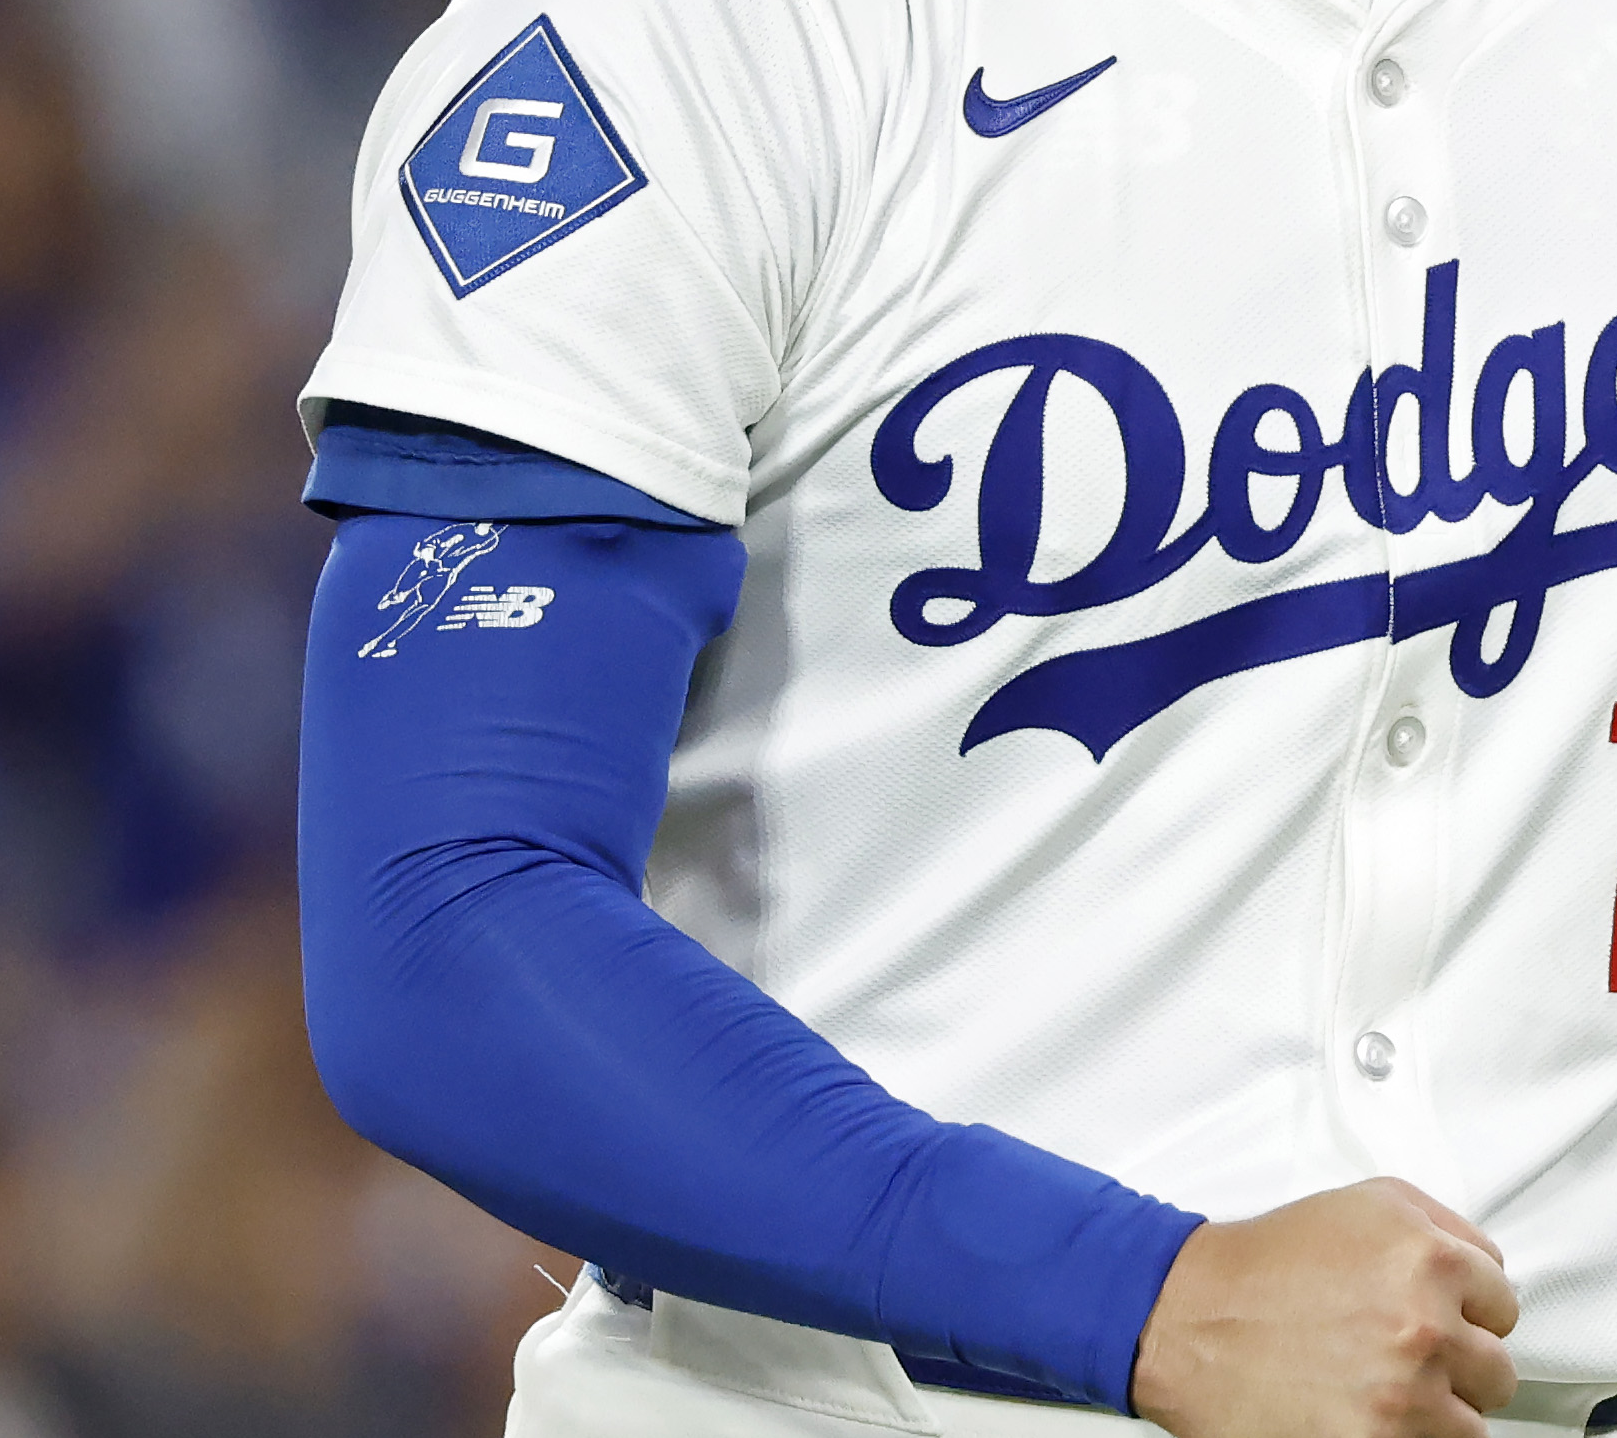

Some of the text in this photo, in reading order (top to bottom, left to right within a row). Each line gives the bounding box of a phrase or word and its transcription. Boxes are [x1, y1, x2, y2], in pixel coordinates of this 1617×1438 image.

[458, 97, 565, 184] G
[423, 188, 566, 220] GUGGENHEIM
[436, 585, 556, 631] NB
